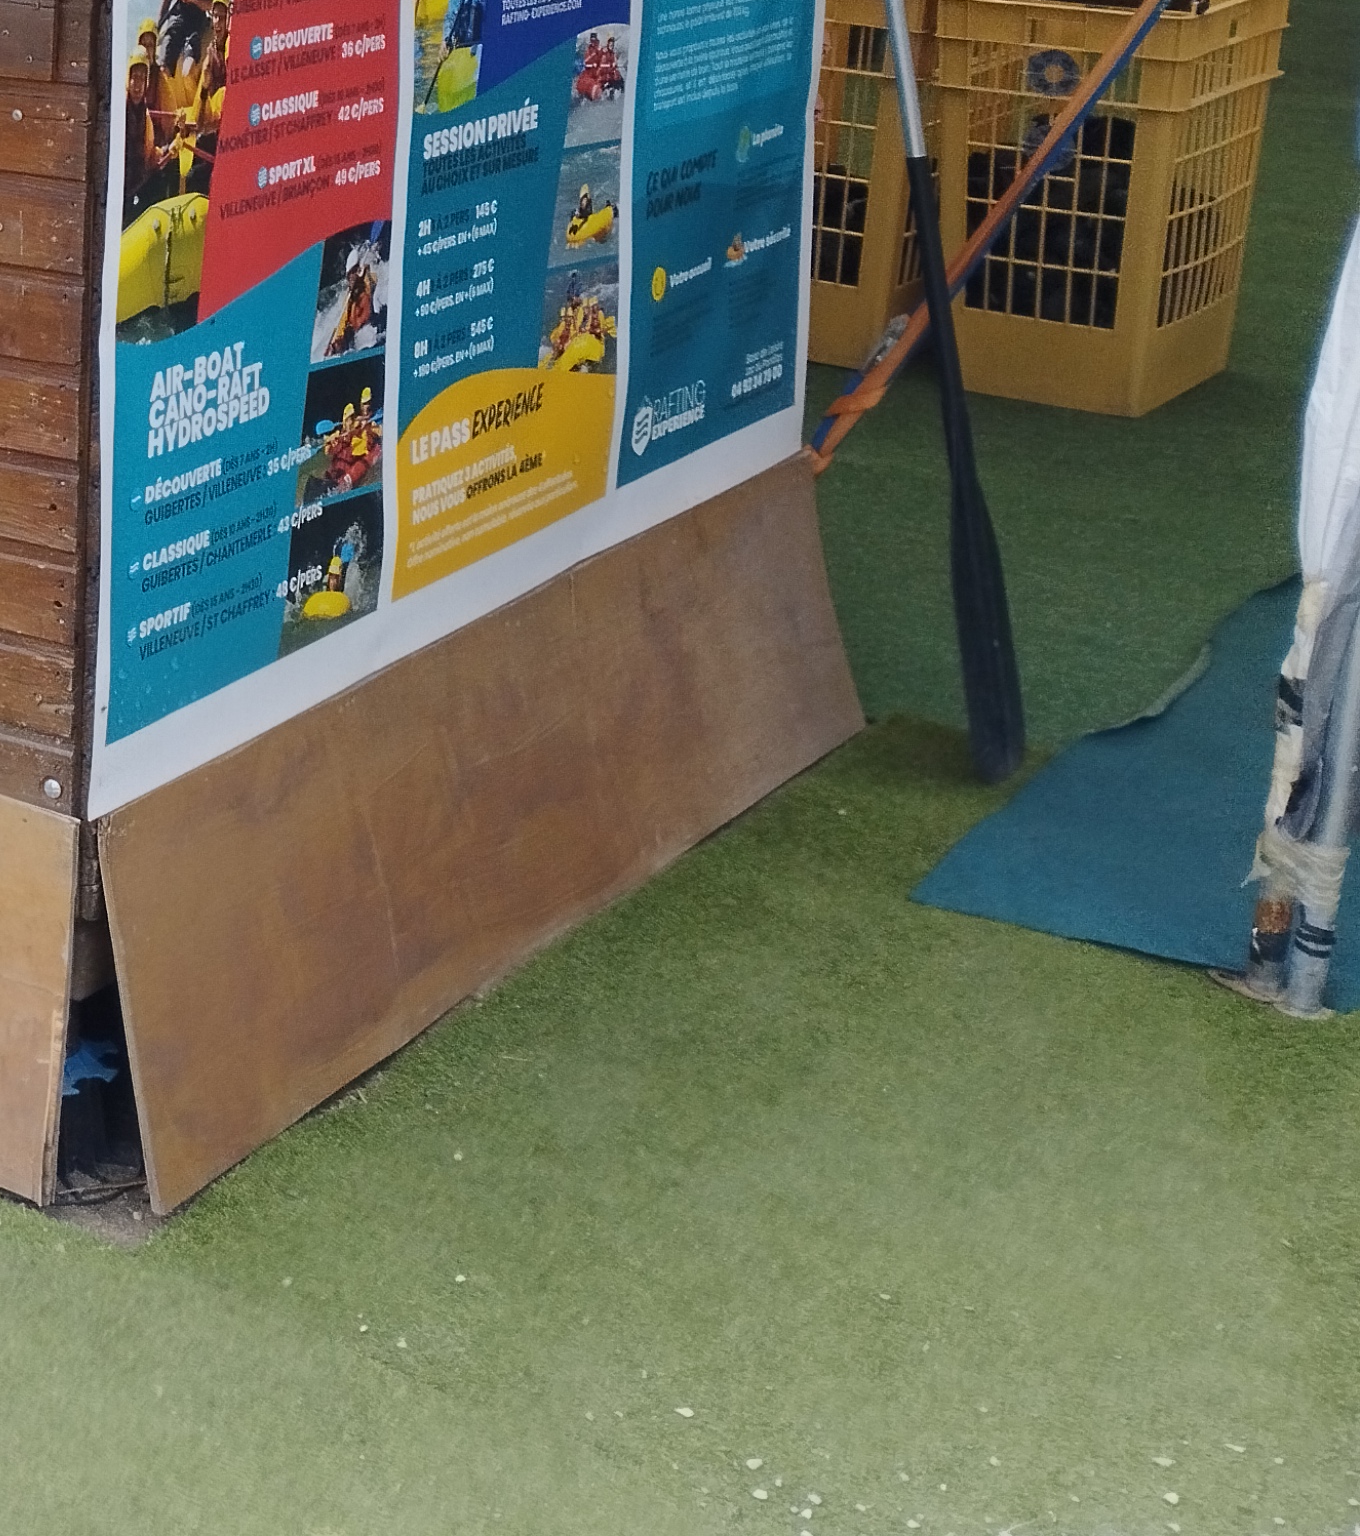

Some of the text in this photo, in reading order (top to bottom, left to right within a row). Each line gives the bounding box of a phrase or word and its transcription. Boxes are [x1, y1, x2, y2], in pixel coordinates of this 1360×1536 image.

[263, 22, 334, 55] DÉCOUVERTE
[341, 41, 353, 59] 36
[261, 90, 320, 121] CLASSIQUE
[337, 105, 350, 122] 42
[423, 118, 487, 160] SESSION
[487, 97, 539, 142] PRIVÉE
[268, 158, 302, 185] SPORT
[302, 155, 316, 175] XL
[334, 169, 347, 186] 49
[416, 278, 431, 299] 4H
[150, 341, 245, 402] AIR-BOAT
[149, 362, 263, 428] CANO-RAFT
[653, 379, 706, 423] RAFTING
[147, 386, 270, 459] HYDROSPEED
[411, 382, 545, 465] LE PASS EXPERIENCE
[652, 403, 705, 441] EXPERIENCE
[144, 458, 223, 505] DÉCOUVERTE
[144, 491, 202, 526] GUIBERTES
[209, 467, 262, 501] VILLENEUVE
[267, 457, 280, 476] 35
[412, 469, 464, 505] PRATIQUEZ
[464, 467, 470, 483] 3
[412, 498, 441, 526] NOUS
[441, 490, 466, 513] VOUS
[466, 469, 506, 500] OFFRONS
[506, 463, 517, 481] LA
[142, 530, 210, 571] CLASSIQUE
[142, 558, 199, 593] GUIBERTES
[206, 524, 272, 564] CHANTEMERLE
[277, 515, 290, 533] 43
[139, 601, 191, 638] SPORTIF
[139, 623, 200, 661] VILLENEUVE
[206, 612, 220, 632] ST
[220, 589, 271, 624] CHAFFREY
[276, 580, 288, 598] 48
